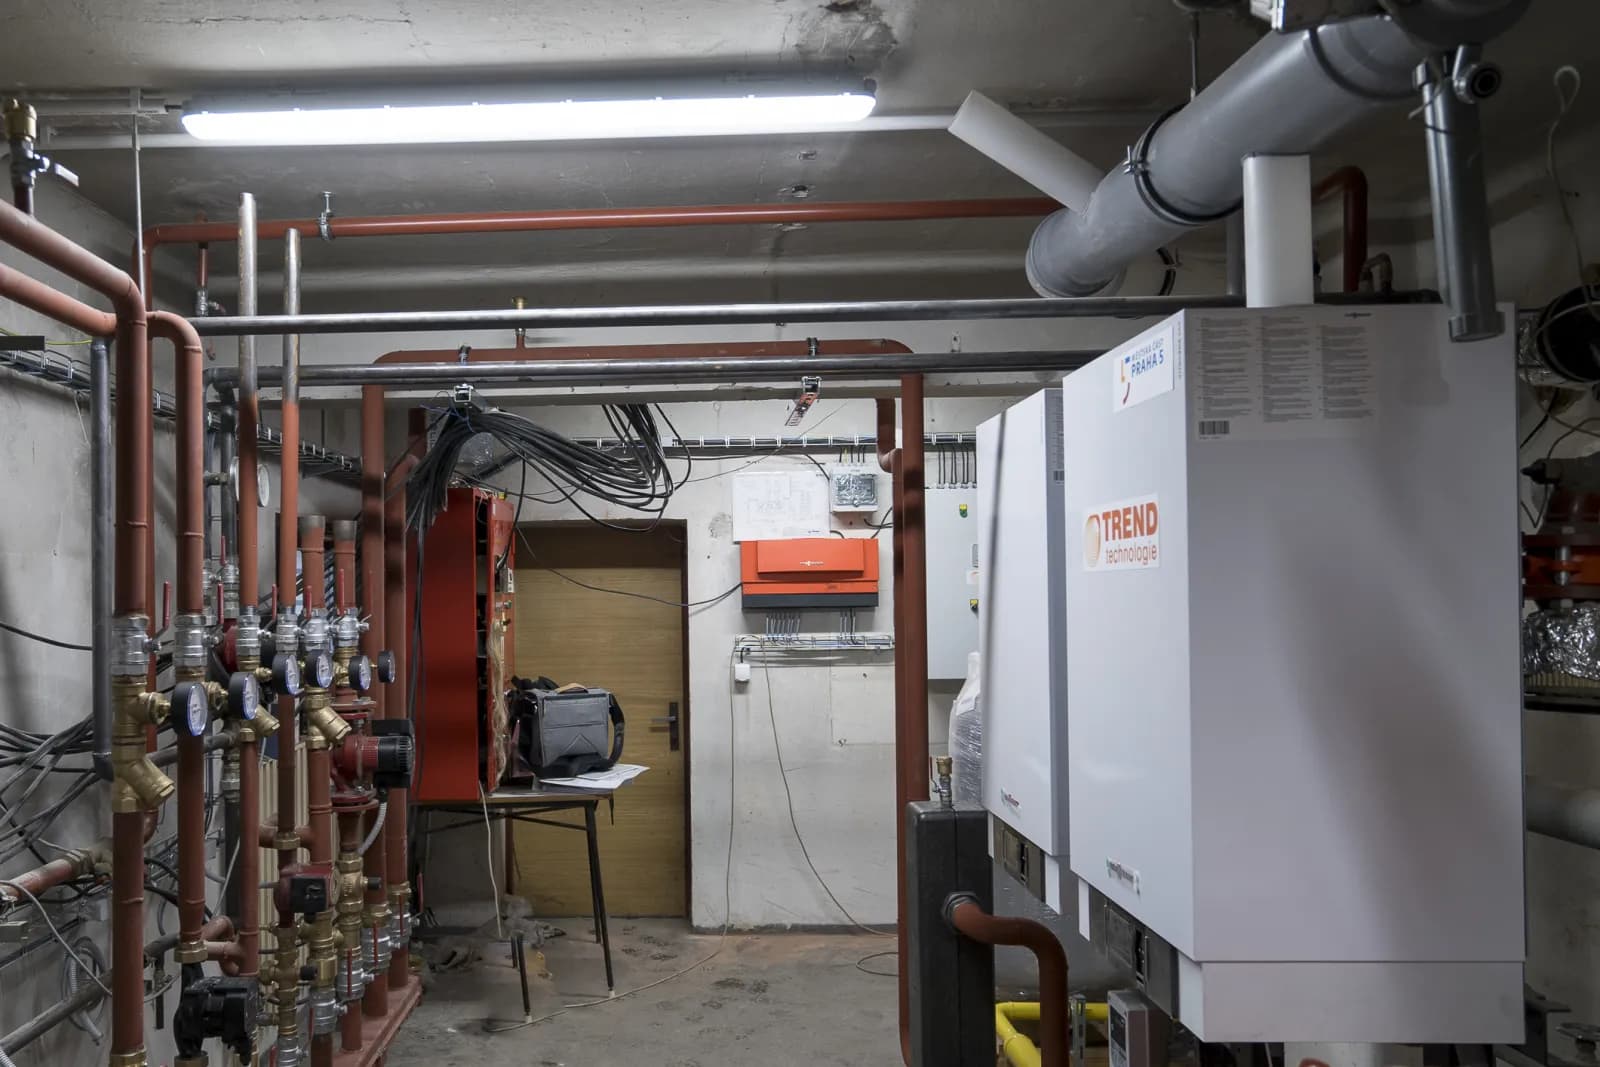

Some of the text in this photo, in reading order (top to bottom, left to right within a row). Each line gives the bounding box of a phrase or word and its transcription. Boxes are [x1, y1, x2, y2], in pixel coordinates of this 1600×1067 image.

[1131, 349, 1164, 377] PRAHA 5
[1102, 502, 1158, 542] TREND
[1105, 540, 1158, 565] technologie
